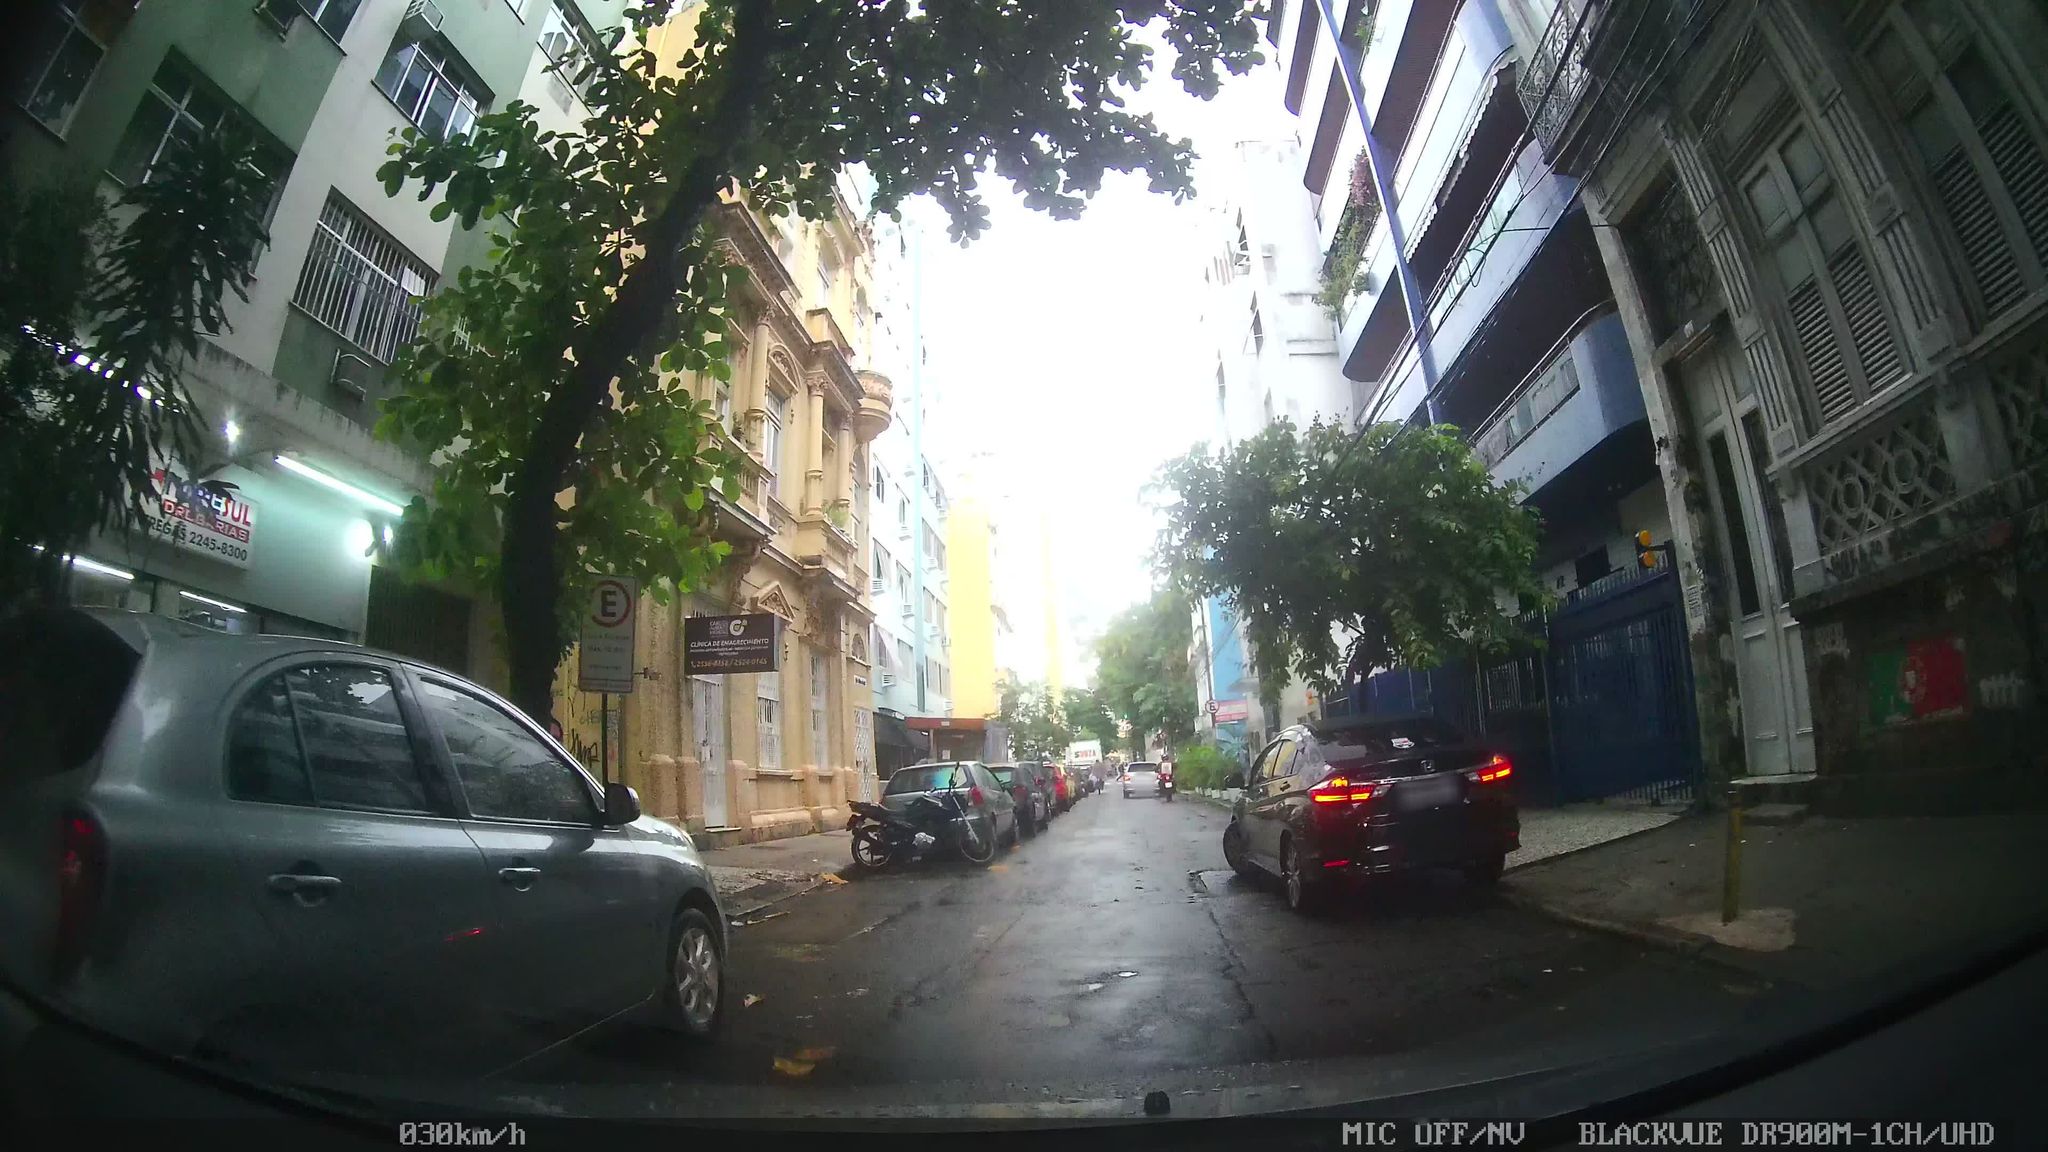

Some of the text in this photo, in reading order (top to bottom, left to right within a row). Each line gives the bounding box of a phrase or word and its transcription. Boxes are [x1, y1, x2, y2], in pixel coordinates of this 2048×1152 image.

[189, 531, 248, 561] 2245-8300
[601, 590, 616, 617] E
[721, 638, 769, 647] EMAGRECIMENTO
